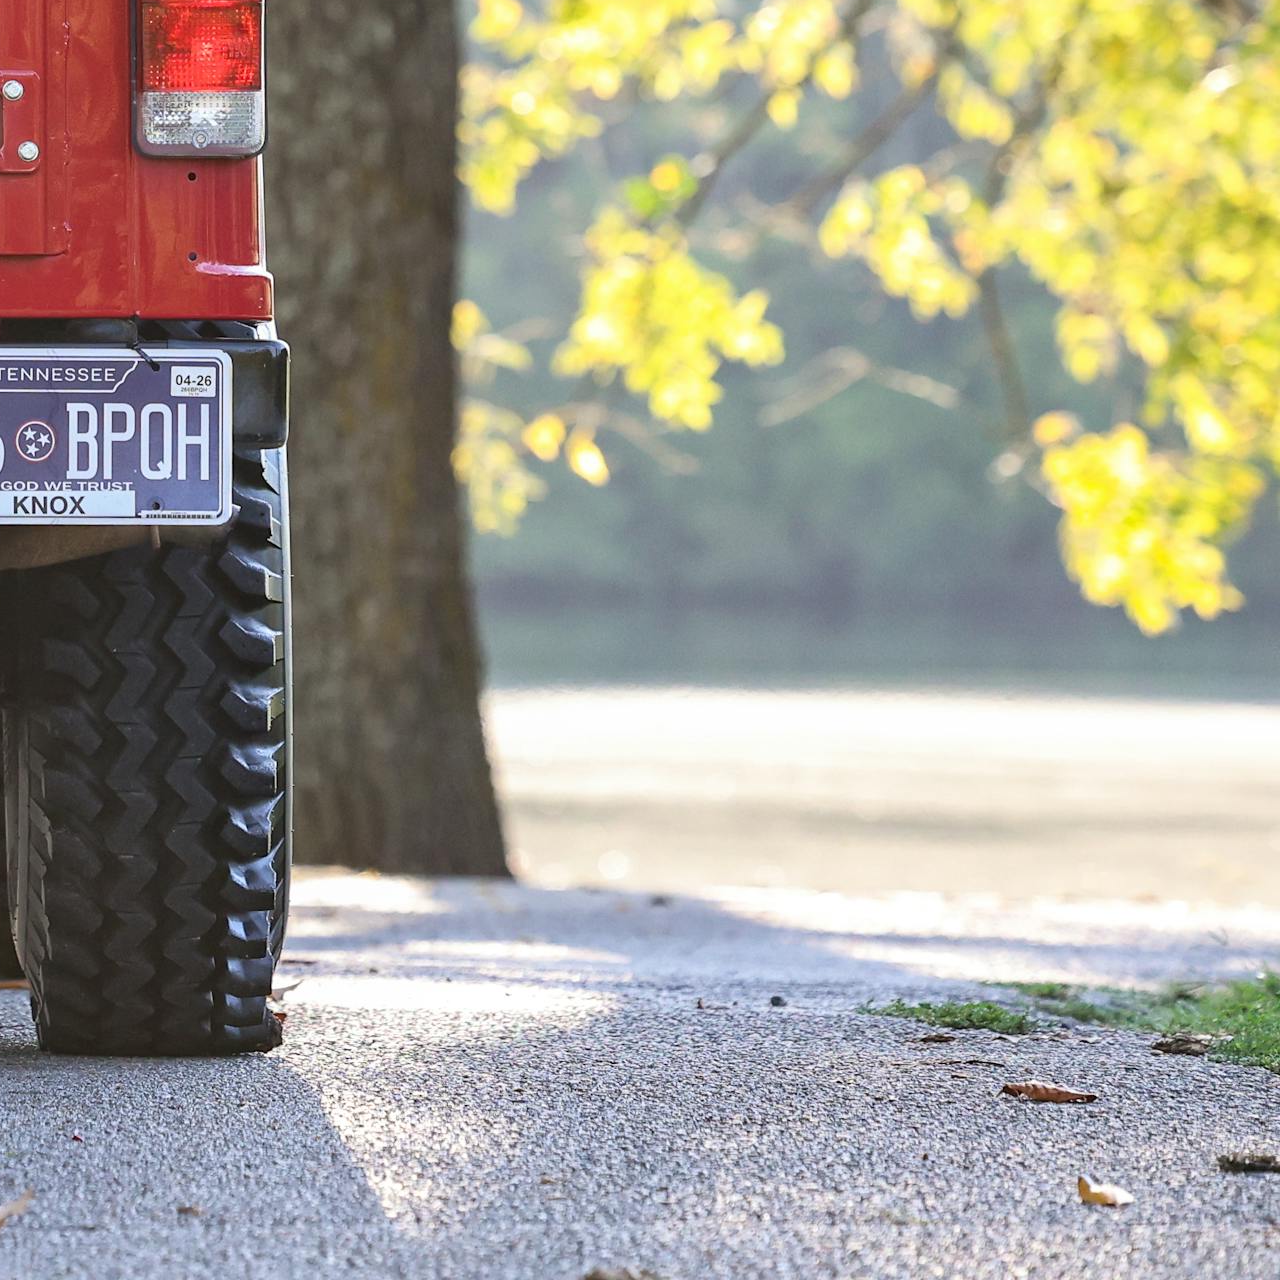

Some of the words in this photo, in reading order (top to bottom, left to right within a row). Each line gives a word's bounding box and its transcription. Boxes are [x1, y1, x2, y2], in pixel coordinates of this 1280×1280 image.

[175, 374, 212, 387] 04-26
[66, 402, 210, 481] BPQH
[0, 480, 39, 491] GOD
[44, 481, 72, 491] WE
[77, 481, 133, 492] TRUST
[13, 496, 86, 515] KNOX
